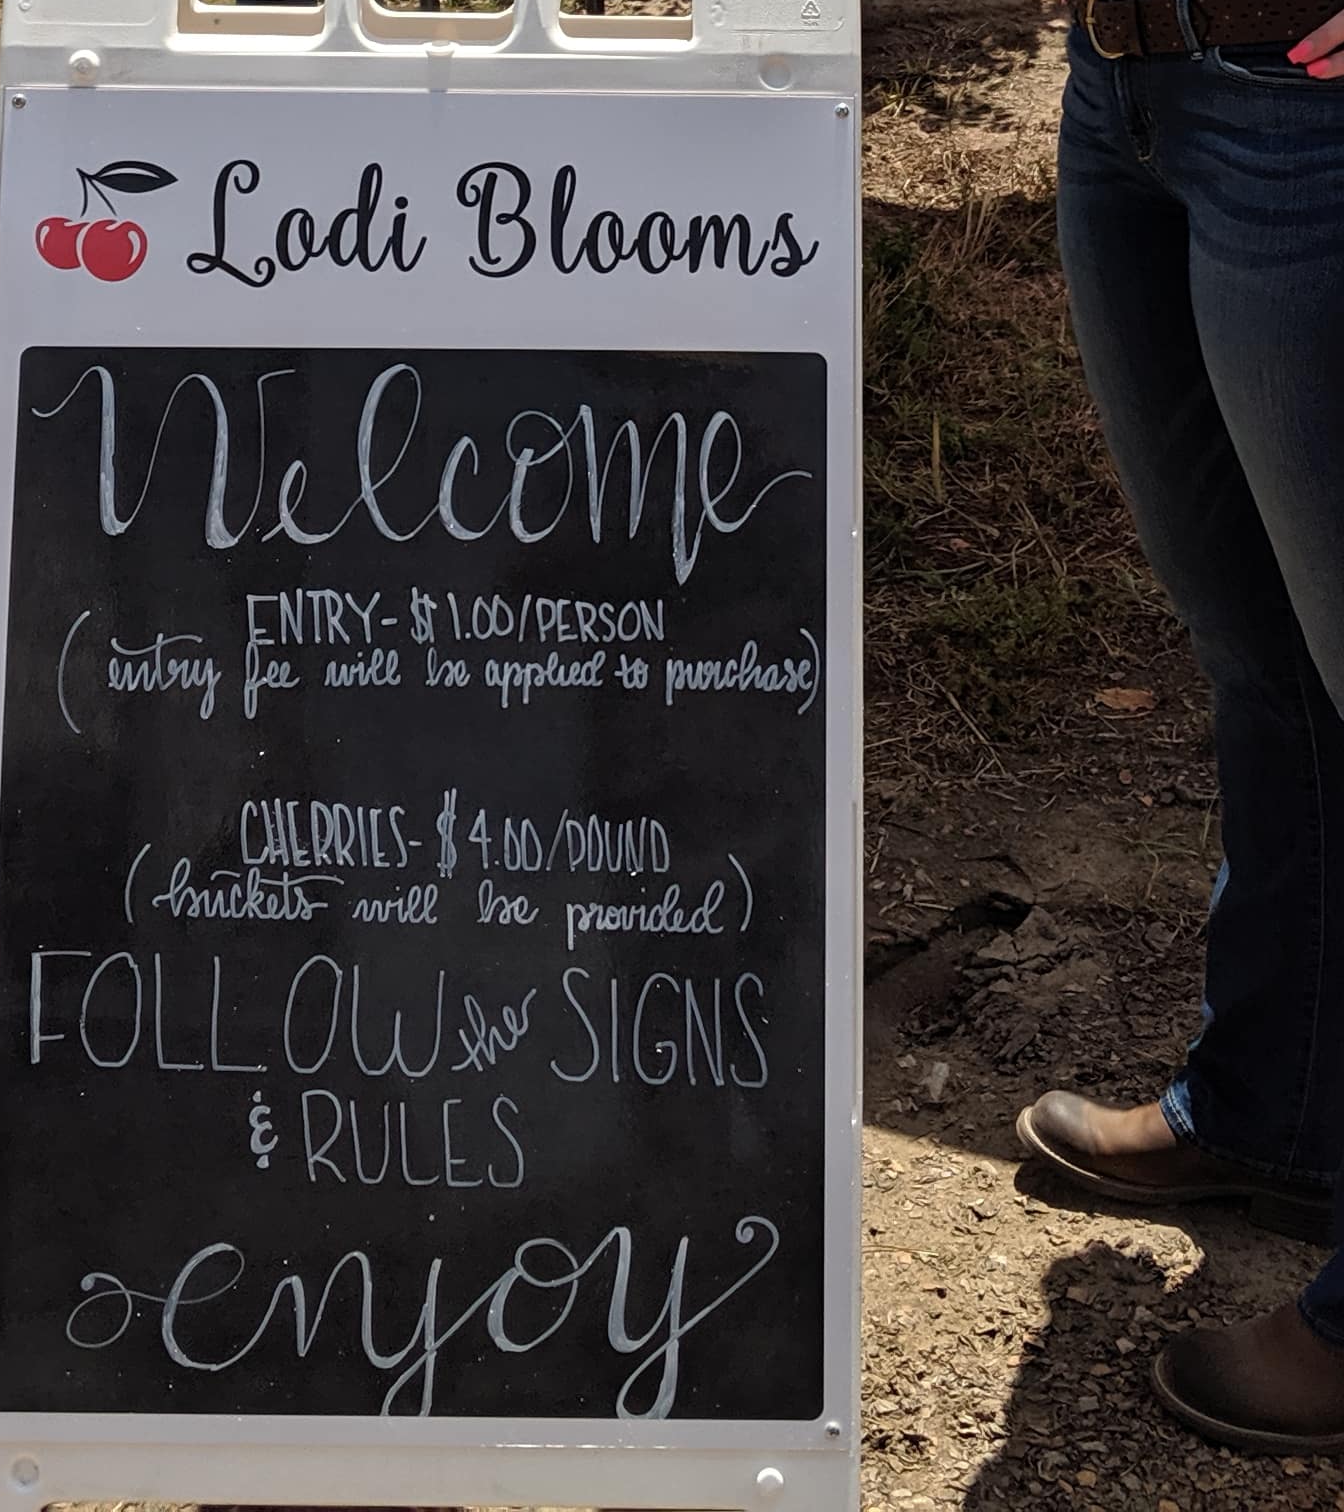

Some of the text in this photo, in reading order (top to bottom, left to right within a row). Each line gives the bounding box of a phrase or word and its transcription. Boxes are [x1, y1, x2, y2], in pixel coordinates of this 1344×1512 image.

[187, 160, 819, 287] Lodi Blooms
[32, 364, 812, 586] Welcome
[244, 643, 300, 719] fee
[325, 648, 401, 687] will
[426, 648, 471, 687] be
[485, 651, 605, 708] applied
[614, 655, 649, 689] to
[352, 884, 438, 924] will
[477, 879, 540, 925] be
[31, 951, 767, 1087] FOLLOW the SIGNS
[249, 1089, 524, 1188] & RULES
[67, 1216, 779, 1419] enjoy
